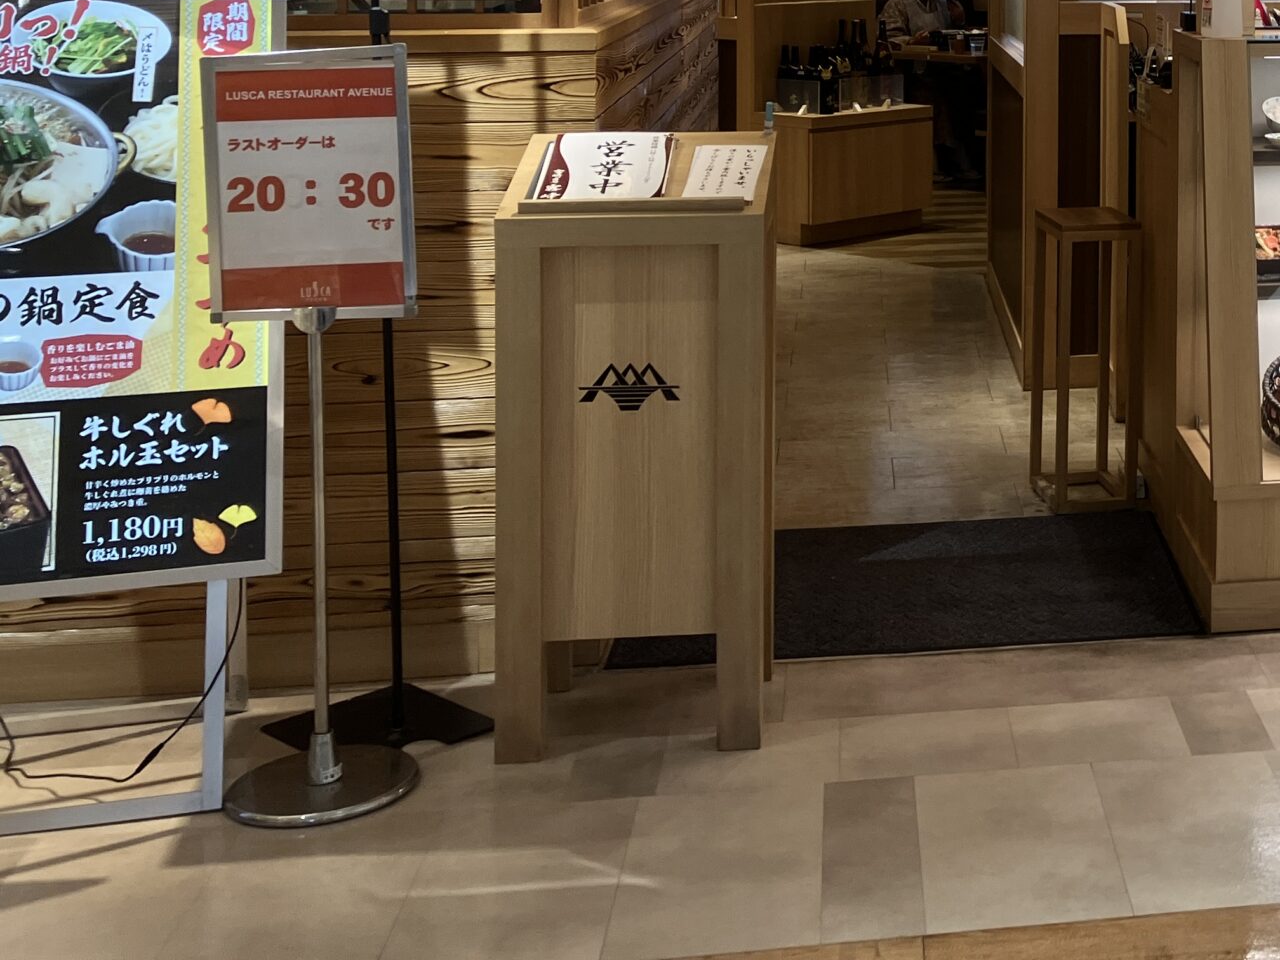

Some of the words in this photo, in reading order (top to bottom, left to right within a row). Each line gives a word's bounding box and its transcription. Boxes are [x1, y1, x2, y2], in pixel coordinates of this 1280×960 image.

[202, 12, 226, 53] 限定
[226, 1, 249, 42] 期間
[226, 90, 266, 101] LUSCA
[268, 88, 345, 100] RESTAURANT
[348, 87, 393, 98] AVENUE
[227, 135, 336, 152] ラストオーダーは
[367, 218, 395, 230] です
[79, 411, 187, 442] 牛しぐれ
[78, 435, 229, 470] ホル玉セット
[82, 514, 184, 546] 1,180円
